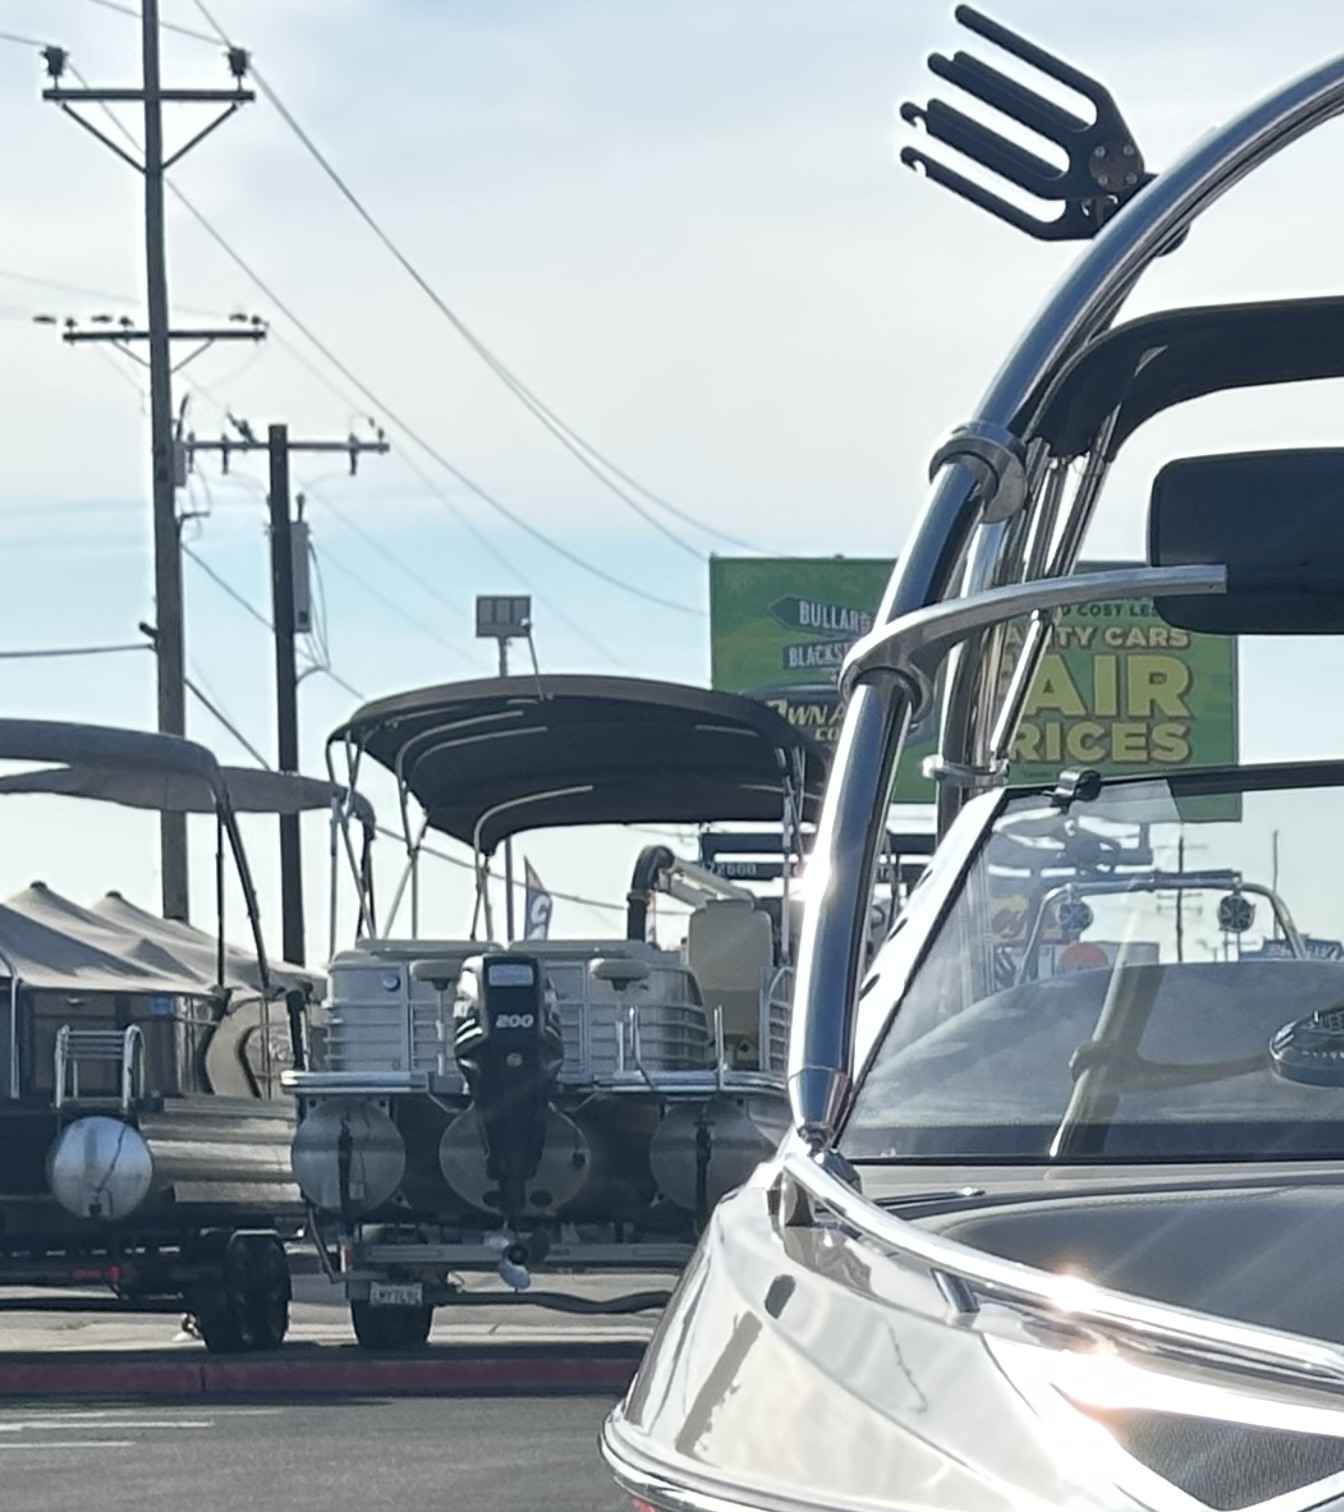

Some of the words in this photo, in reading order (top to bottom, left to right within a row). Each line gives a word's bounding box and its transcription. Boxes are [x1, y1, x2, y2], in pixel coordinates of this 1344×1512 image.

[1104, 626, 1190, 648] CARS
[788, 641, 849, 667] BLACKS
[1001, 653, 1192, 717] AIR
[1008, 722, 1191, 763] RICES
